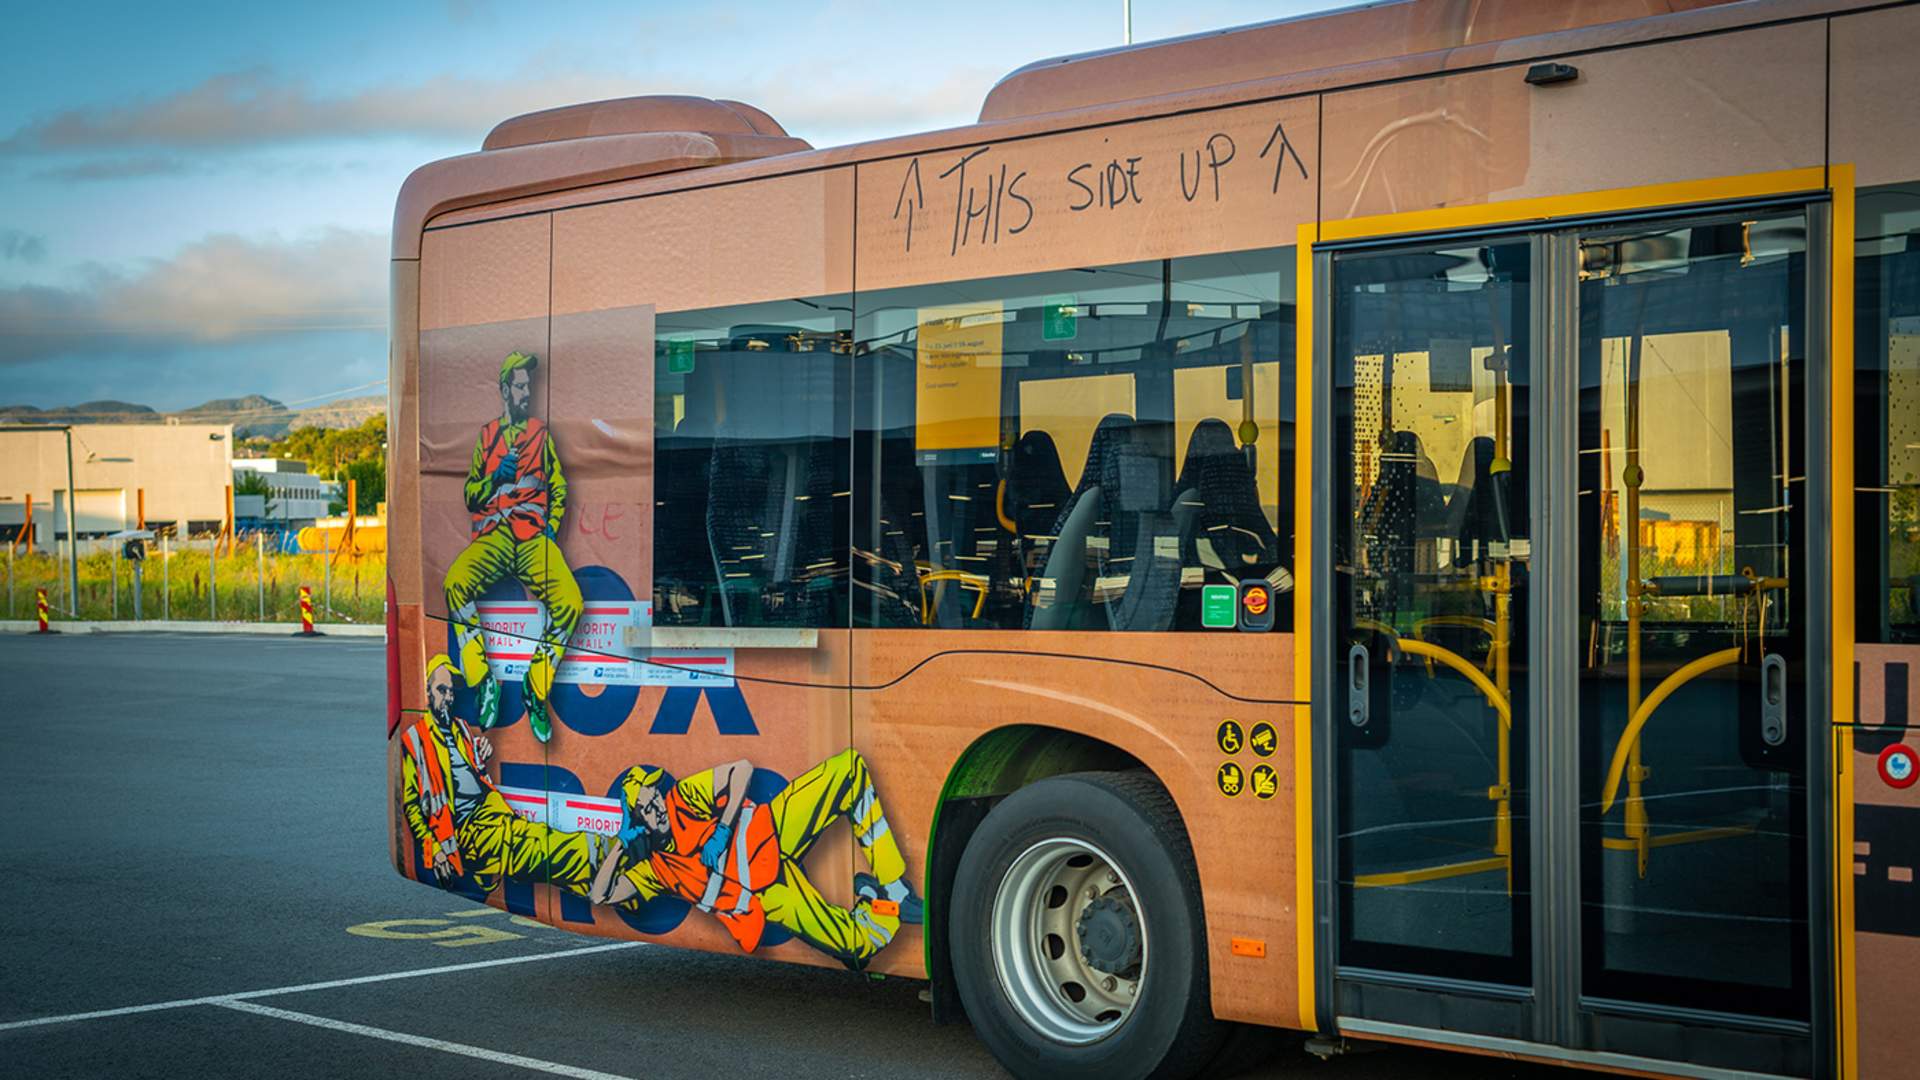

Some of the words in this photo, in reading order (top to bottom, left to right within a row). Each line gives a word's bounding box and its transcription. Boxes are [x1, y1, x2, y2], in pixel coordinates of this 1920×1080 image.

[940, 147, 1033, 256] THIS
[1180, 133, 1235, 201] UP
[488, 635, 513, 647] MAIL
[575, 637, 603, 649] MAIL
[577, 815, 621, 832] PRIORIT
